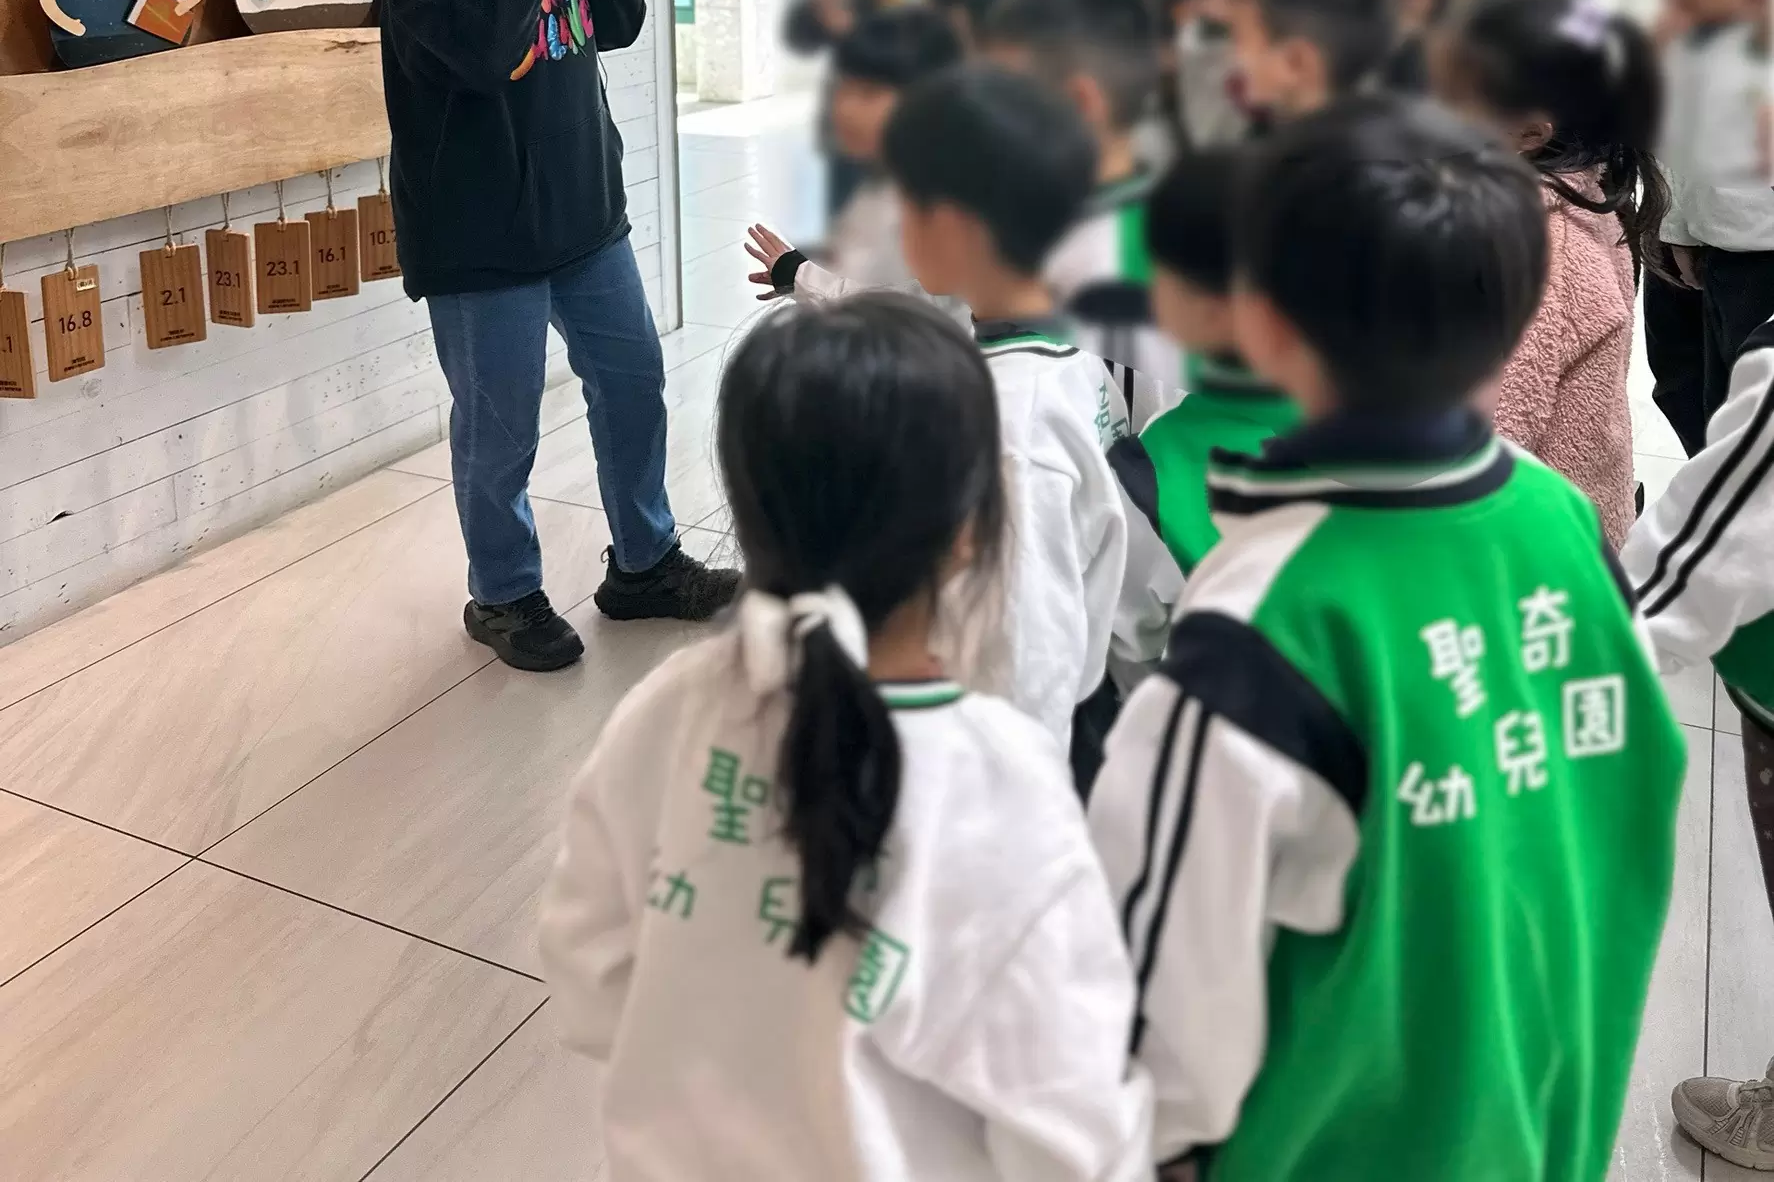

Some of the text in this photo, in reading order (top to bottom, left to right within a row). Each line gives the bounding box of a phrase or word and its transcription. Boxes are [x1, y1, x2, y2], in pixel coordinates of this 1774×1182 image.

[318, 246, 347, 263] 16.1
[266, 260, 300, 277] 23.1
[215, 270, 241, 289] 23.1
[161, 287, 186, 306] 2.1
[58, 310, 93, 335] 16.8
[1396, 672, 1627, 827] 幼兒園
